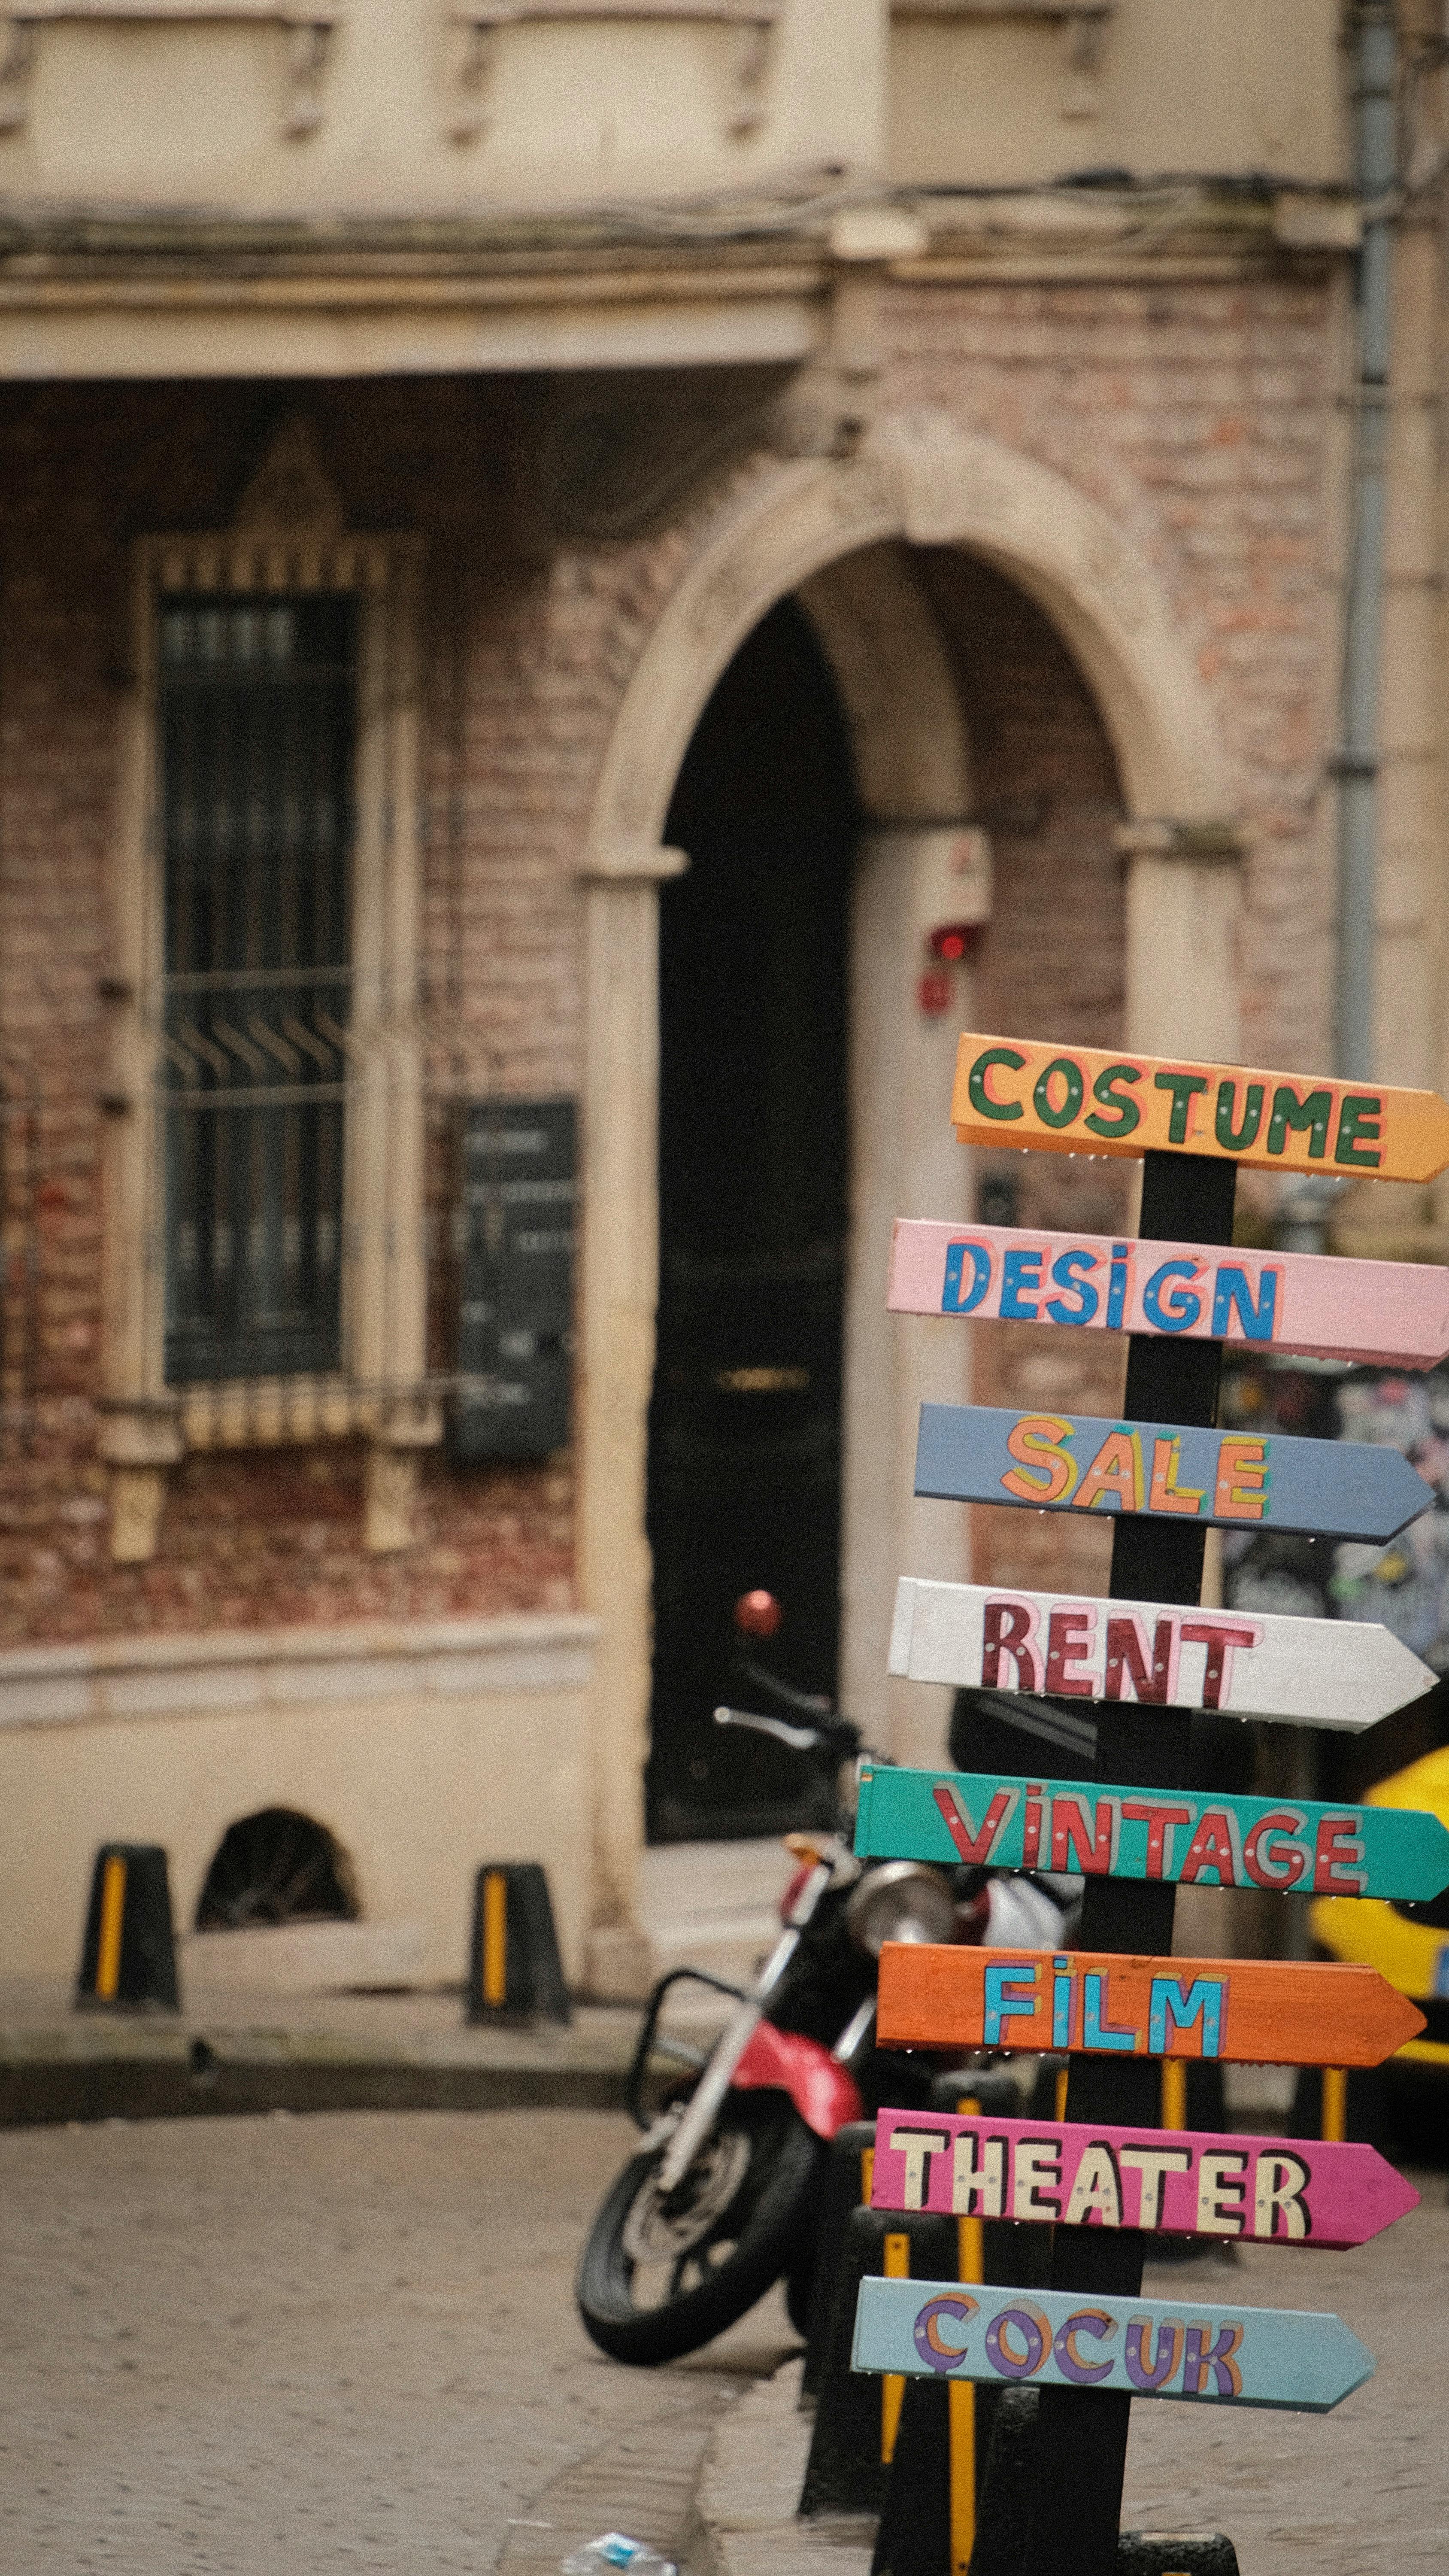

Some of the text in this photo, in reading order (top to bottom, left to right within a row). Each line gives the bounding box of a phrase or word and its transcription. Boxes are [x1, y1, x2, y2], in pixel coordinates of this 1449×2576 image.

[968, 1042, 1389, 1168] COSTUME
[1000, 1415, 1271, 1519] SALE
[981, 1594, 1264, 1710] RENT
[889, 2126, 1312, 2239] THEATER
